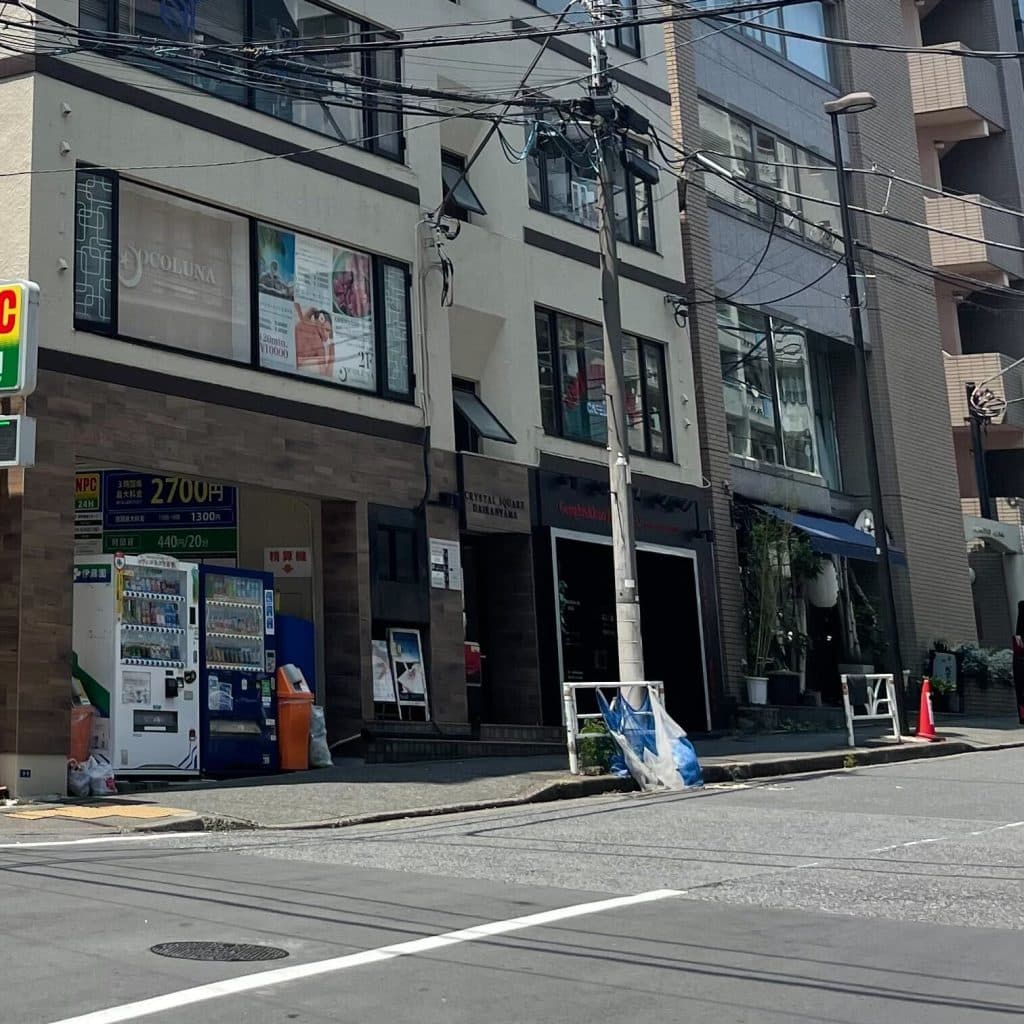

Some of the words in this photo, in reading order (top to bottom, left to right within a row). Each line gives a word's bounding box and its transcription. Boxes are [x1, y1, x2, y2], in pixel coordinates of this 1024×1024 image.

[75, 477, 97, 492] NPC
[151, 476, 224, 504] 2700円
[78, 499, 95, 508] 24H
[465, 491, 495, 505] CRYSTAL
